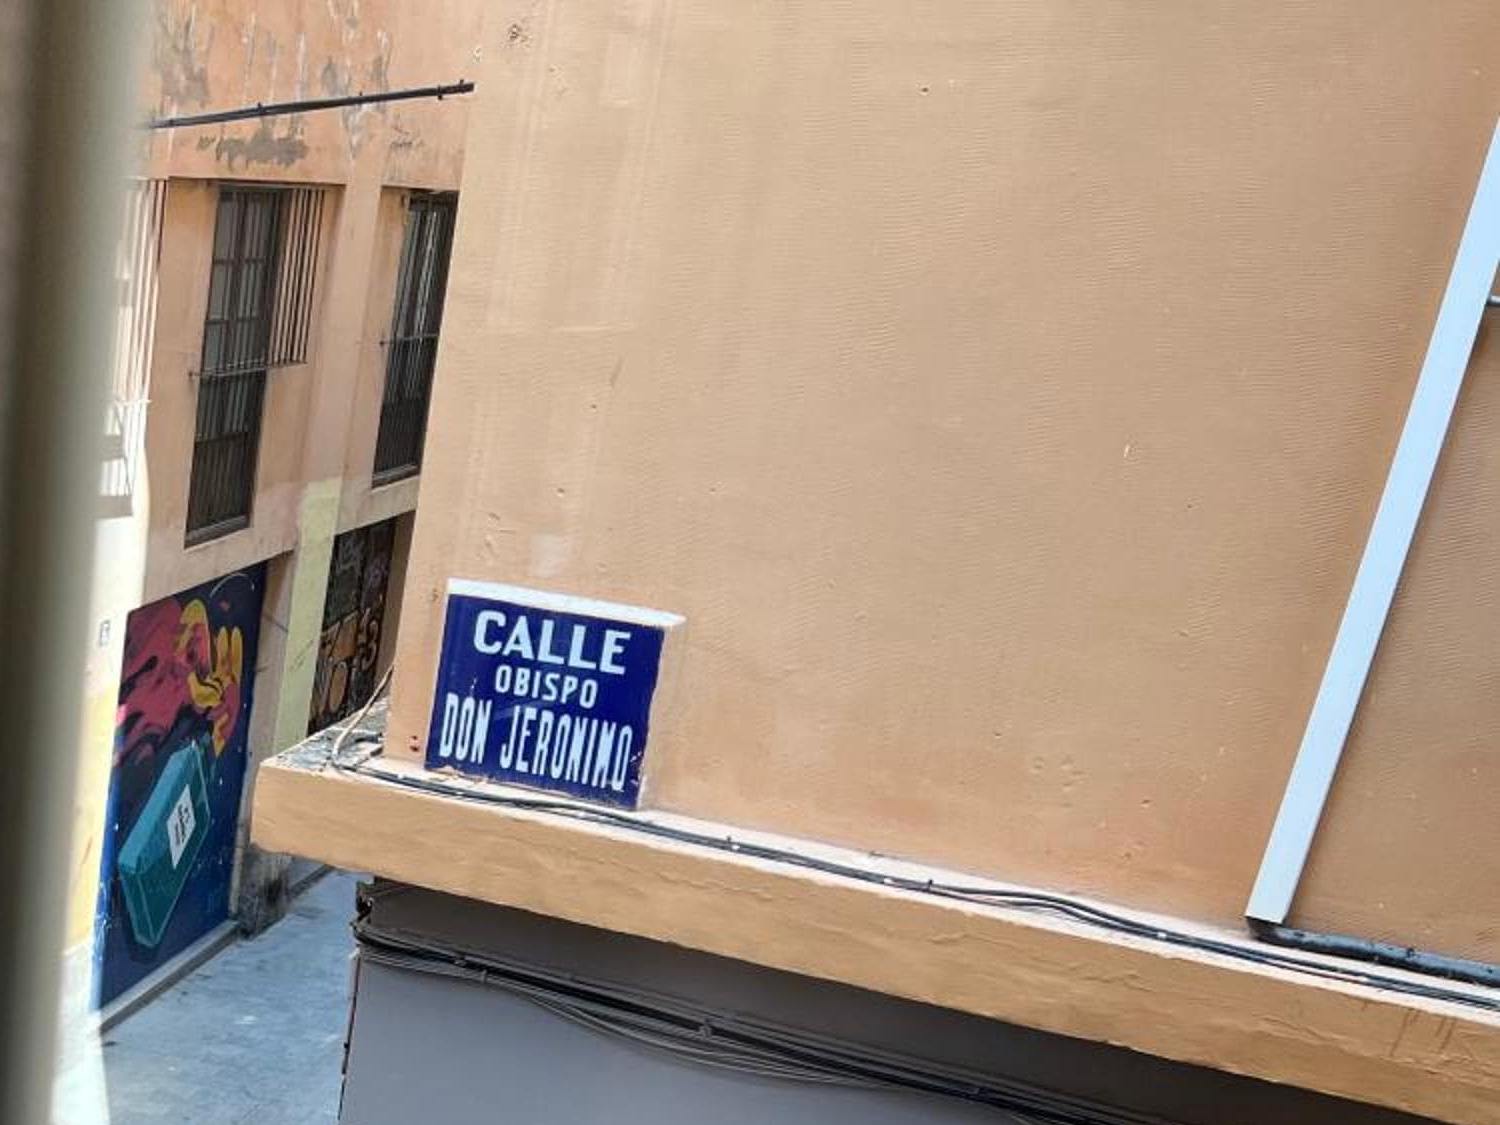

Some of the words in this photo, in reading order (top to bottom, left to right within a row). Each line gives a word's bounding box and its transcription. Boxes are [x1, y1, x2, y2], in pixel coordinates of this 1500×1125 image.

[473, 610, 631, 675] CALLE
[495, 665, 598, 709] OBISPO
[439, 692, 493, 765] DON
[500, 705, 633, 791] JERONIMO
